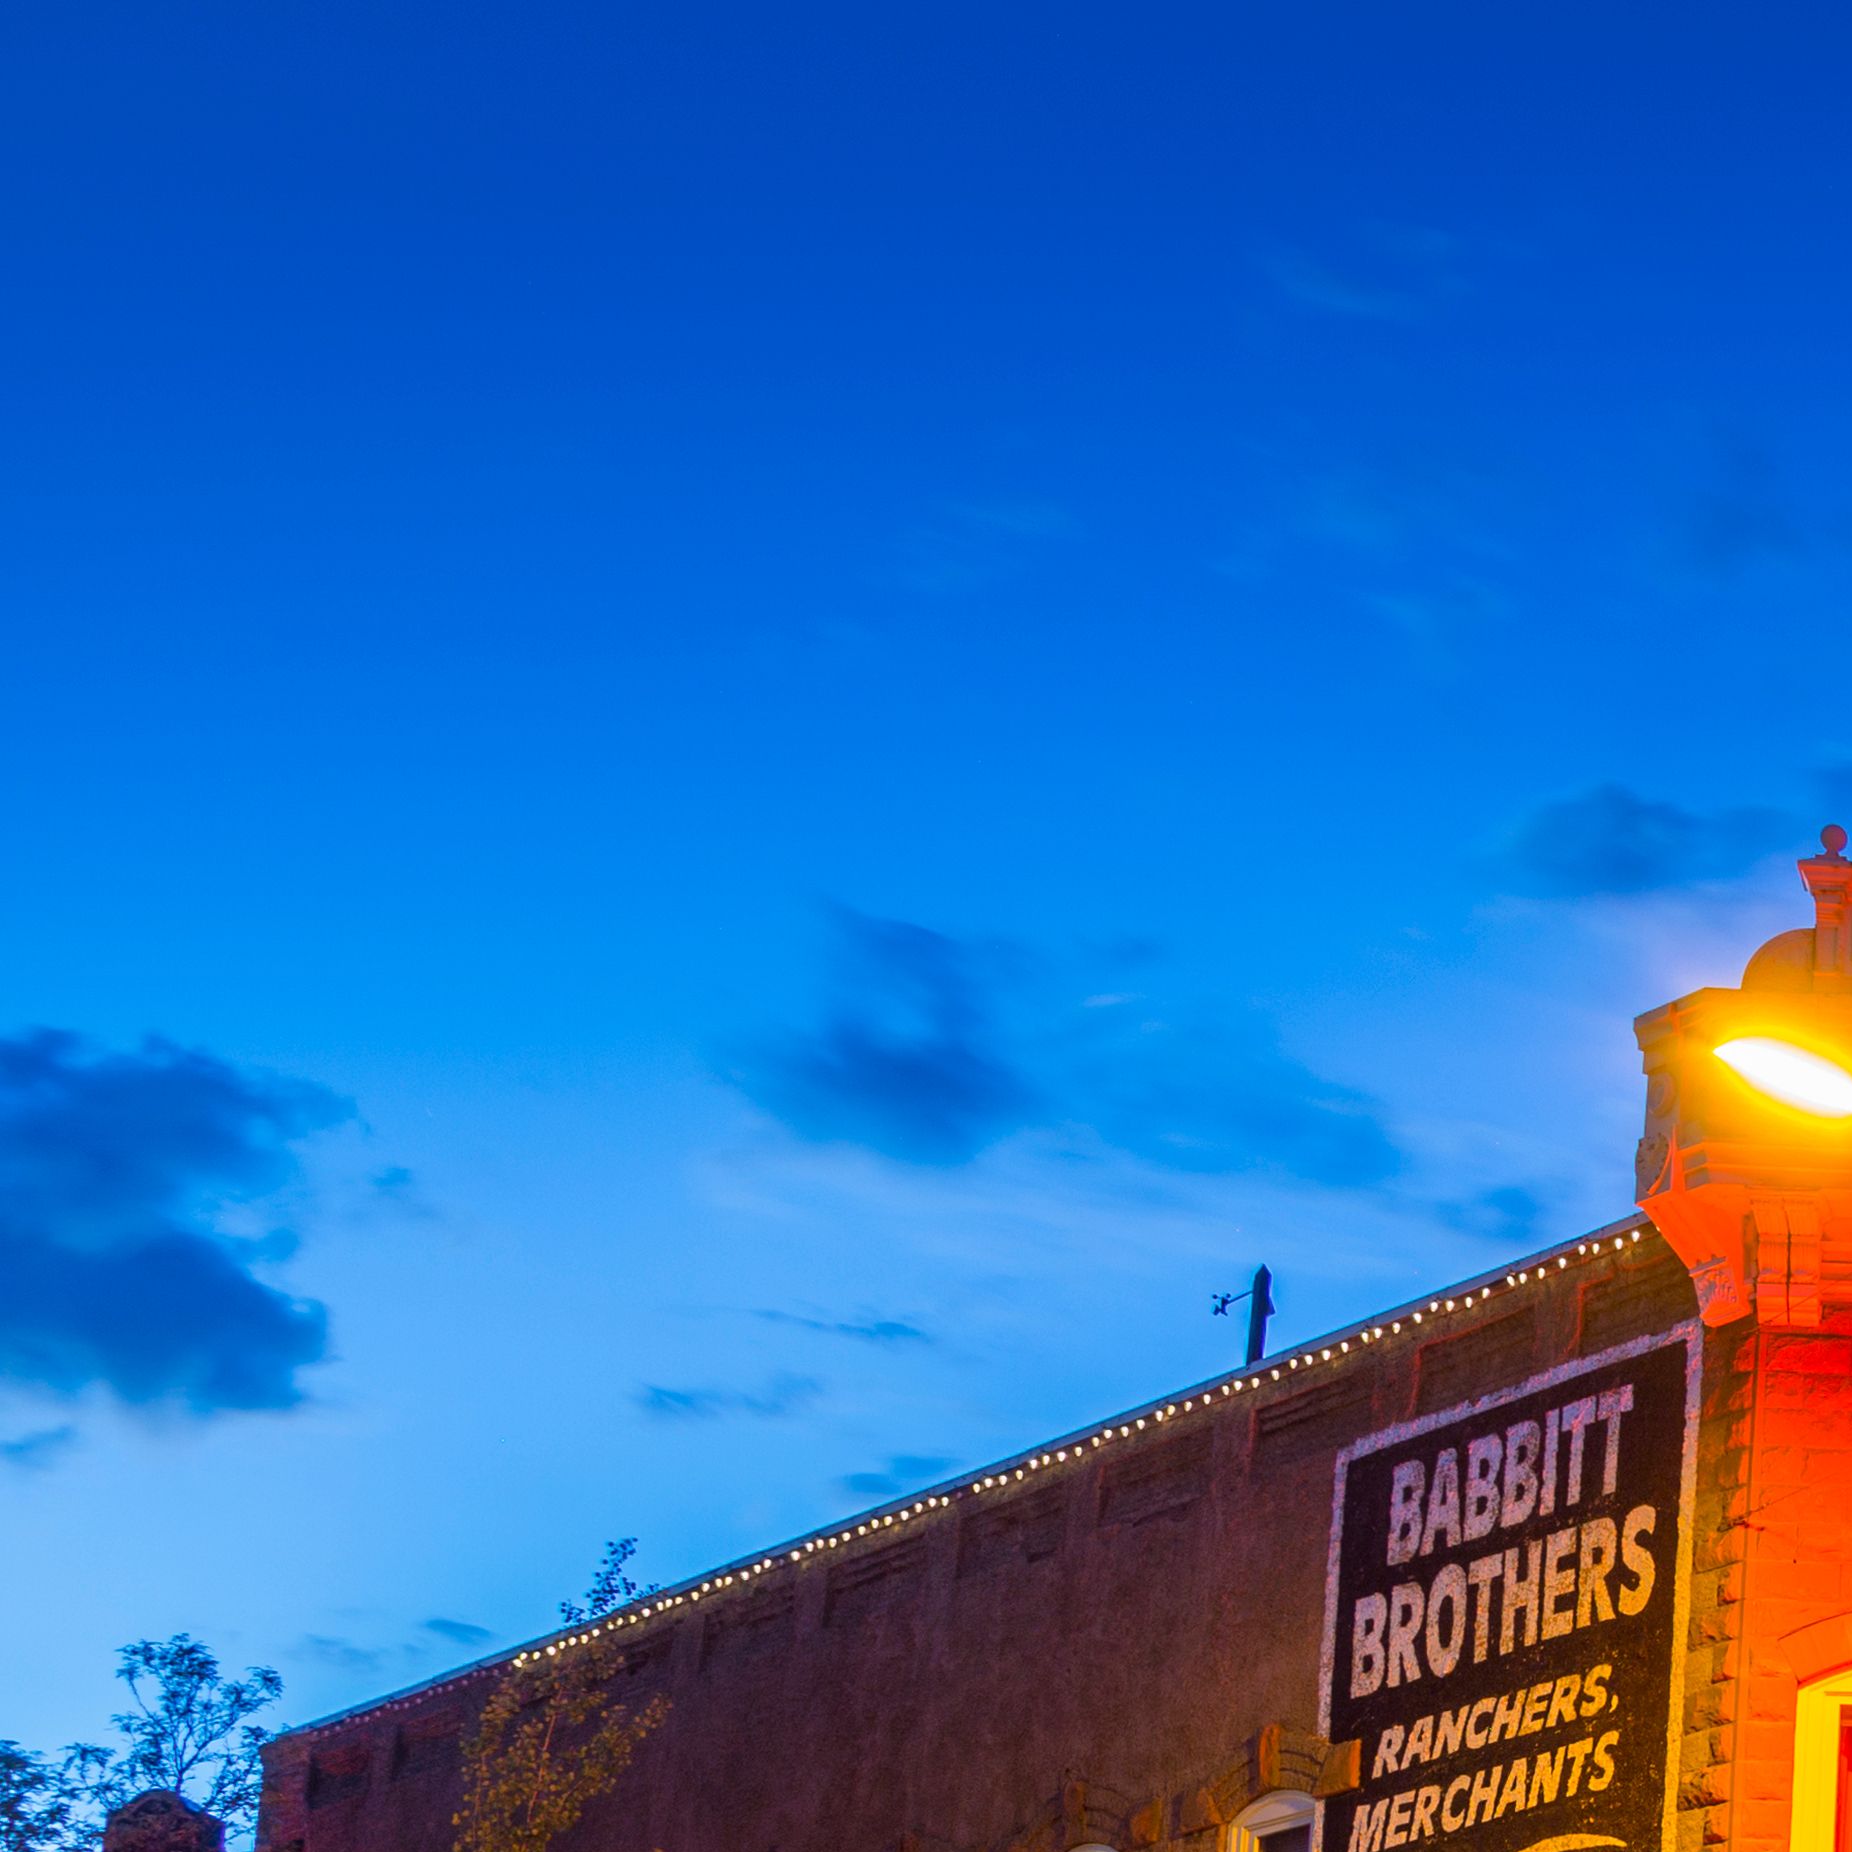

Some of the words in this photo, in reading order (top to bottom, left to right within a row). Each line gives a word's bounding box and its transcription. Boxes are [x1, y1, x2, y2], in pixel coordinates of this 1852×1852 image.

[1386, 1383, 1634, 1567] BABBITT
[1350, 1504, 1657, 1700] BROTHERS
[1371, 1663, 1619, 1780] RANCHERS,
